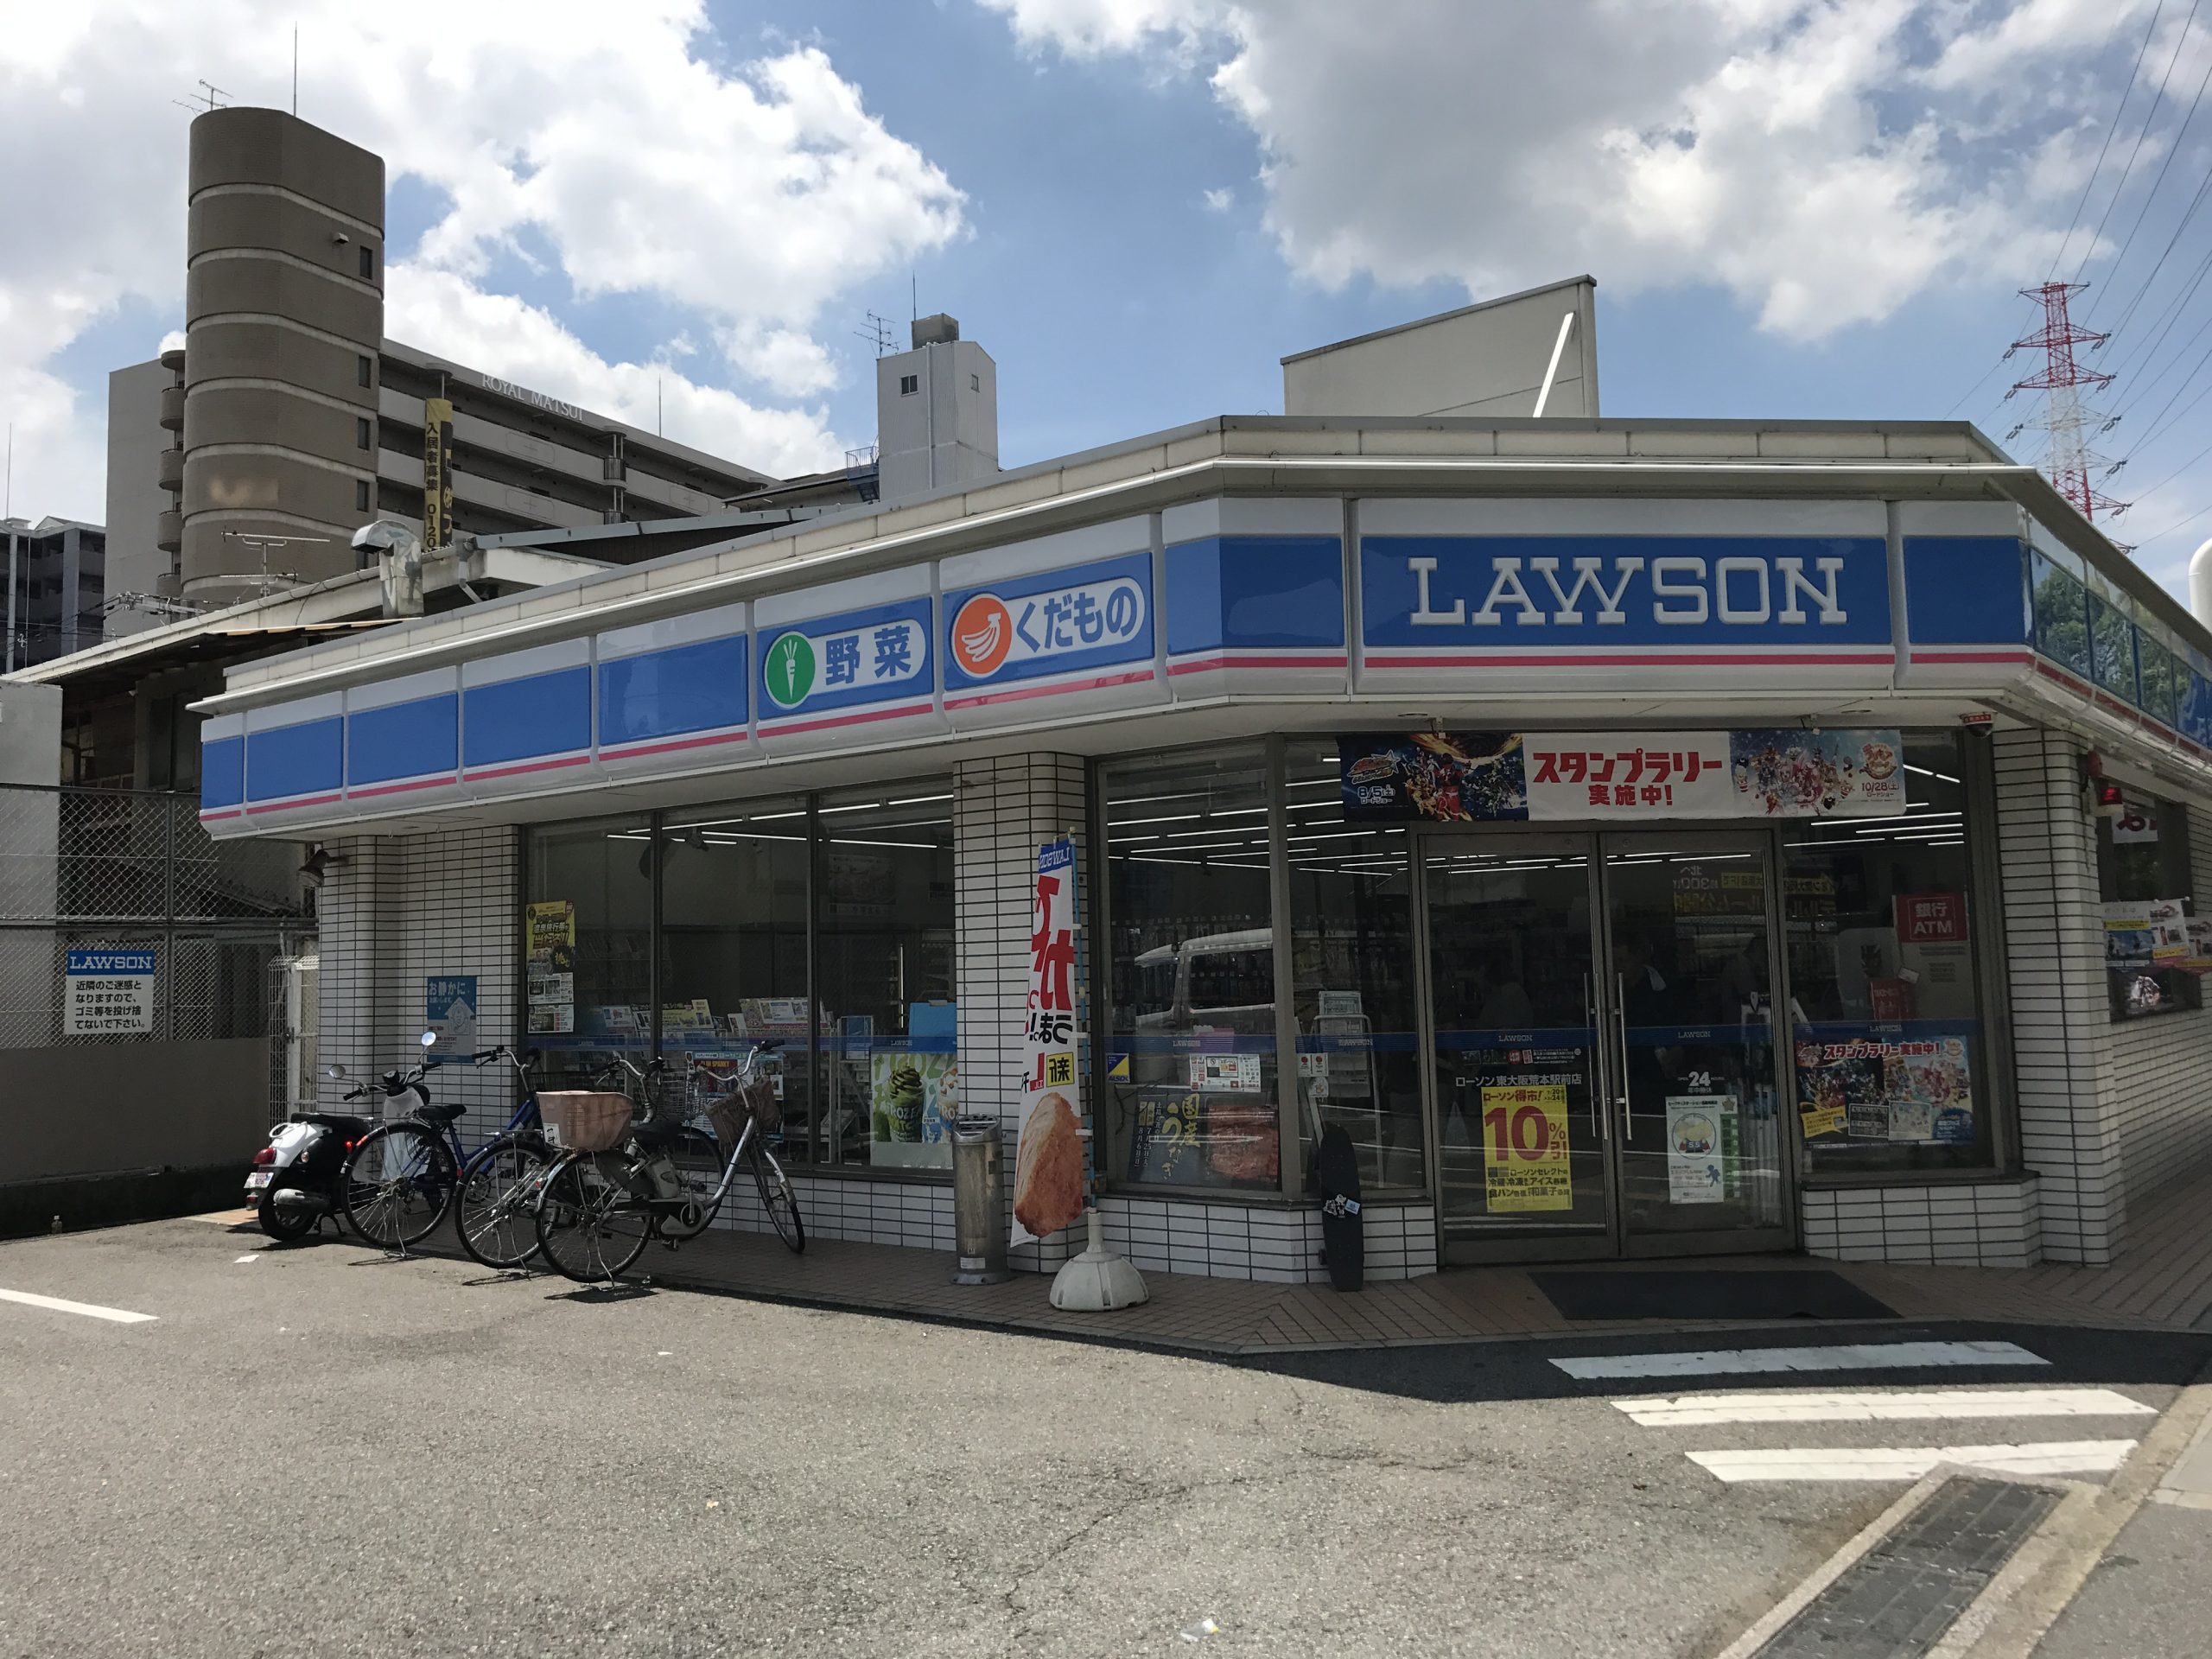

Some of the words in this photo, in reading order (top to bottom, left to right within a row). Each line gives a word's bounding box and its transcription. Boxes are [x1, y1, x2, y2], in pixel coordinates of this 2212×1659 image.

[482, 374, 524, 401] ROYAL
[531, 391, 583, 421] MATSUI
[426, 423, 439, 491] 入居者募集
[1408, 556, 1847, 626] LAWSON
[1015, 585, 1138, 653] くだもの
[824, 625, 912, 686] 野菜
[1533, 747, 1723, 783] スタンプラリー
[1588, 784, 1673, 805] 実施中!
[1915, 902, 1948, 918] 銀行
[1913, 919, 1954, 935] ATM
[69, 956, 152, 969] LAWSON
[75, 980, 142, 991] 近隣のご迷惑と
[428, 981, 466, 996] お静かに
[75, 993, 137, 1003] なりますので、
[75, 1006, 142, 1016] ゴミ等を投げ捨
[74, 1019, 145, 1030] てないで下さい。
[1677, 1030, 1711, 1039] LAWSON
[1455, 1075, 1495, 1087] ローソン
[1688, 1071, 1712, 1087] 24
